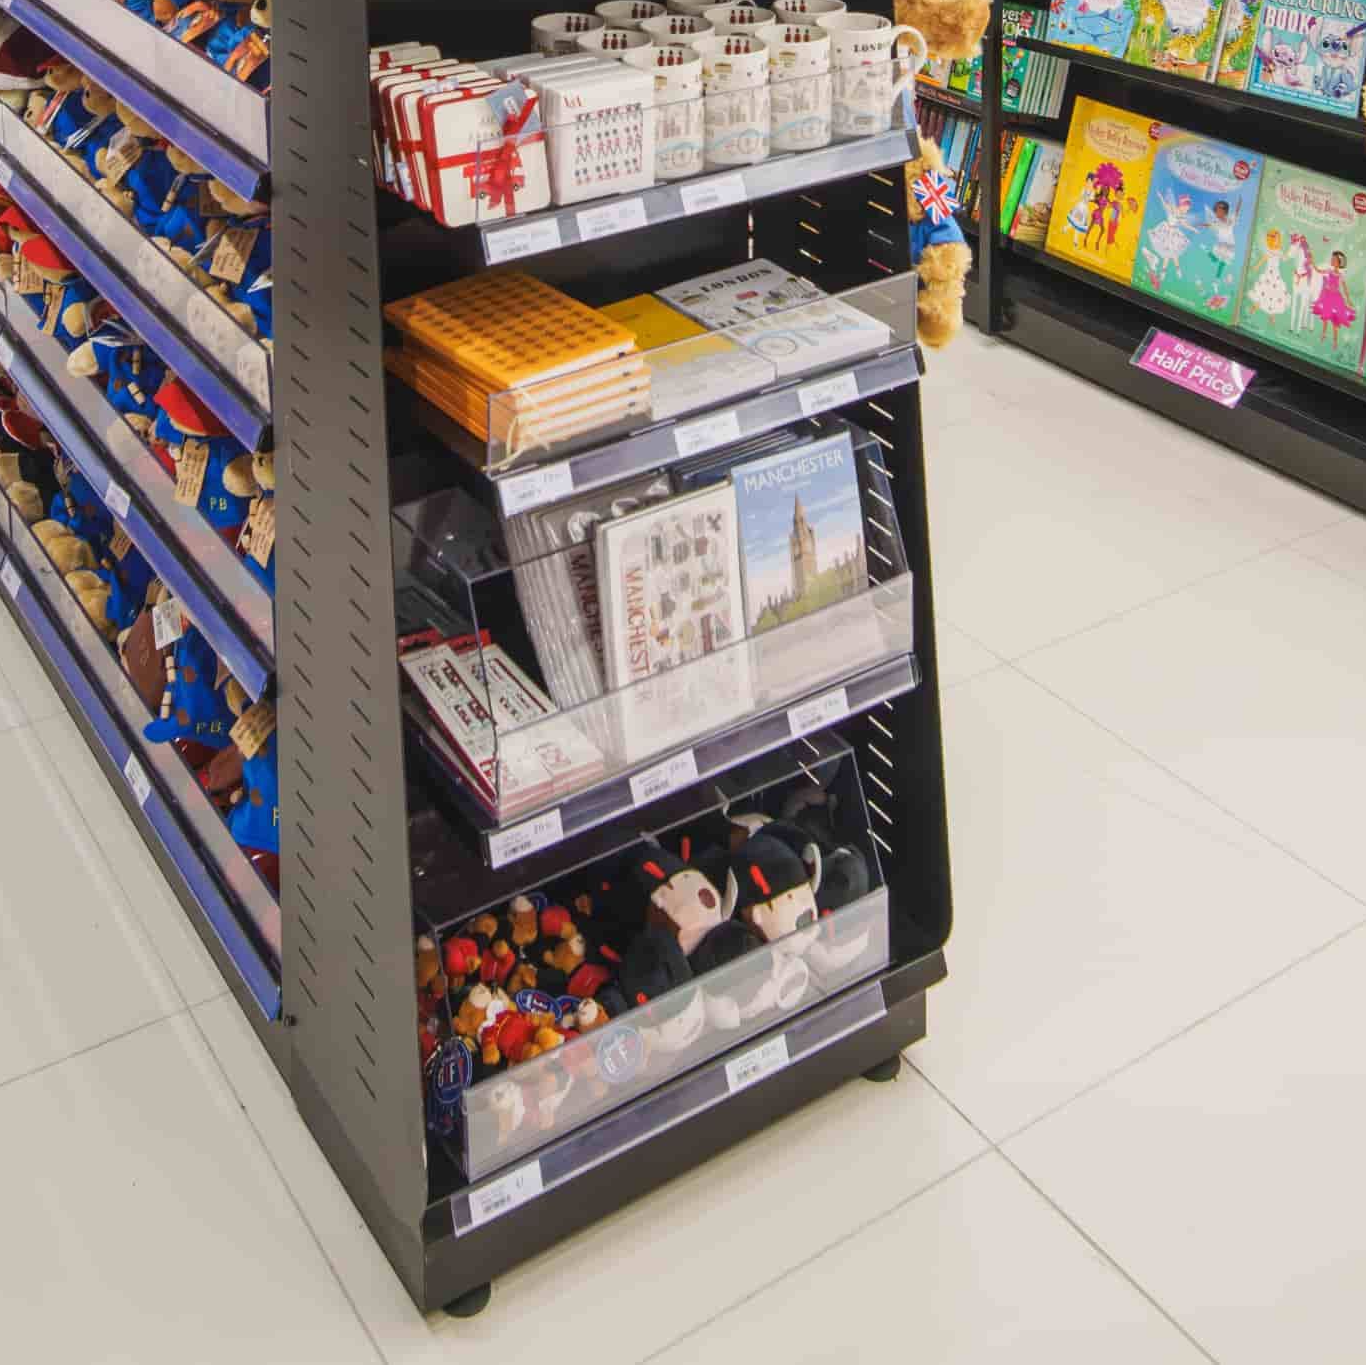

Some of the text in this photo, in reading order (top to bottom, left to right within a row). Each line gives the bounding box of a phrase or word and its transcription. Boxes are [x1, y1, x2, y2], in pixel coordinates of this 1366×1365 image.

[1263, 6, 1315, 35] BOOK
[853, 42, 891, 53] LOND
[700, 265, 775, 294] LONDON
[1174, 342, 1194, 360] Buy
[1149, 347, 1236, 396] Half Price
[743, 448, 844, 491] MANCHESTER
[570, 551, 604, 655] MANCHES
[624, 566, 653, 696] MANCHEST
